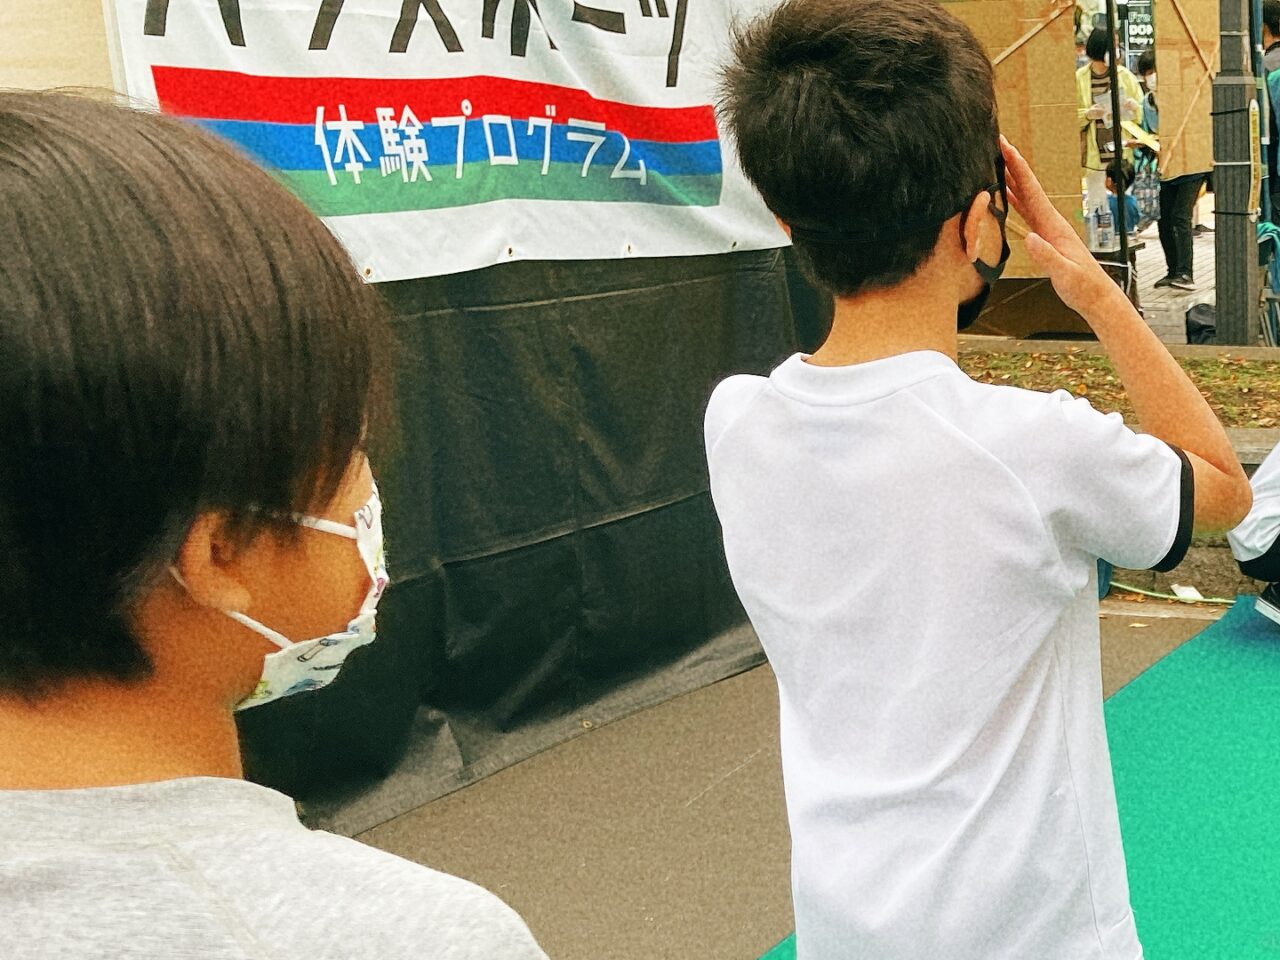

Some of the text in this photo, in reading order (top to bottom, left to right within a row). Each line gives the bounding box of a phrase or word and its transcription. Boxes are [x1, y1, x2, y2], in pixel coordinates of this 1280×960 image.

[313, 98, 648, 187] 体験プログラム
